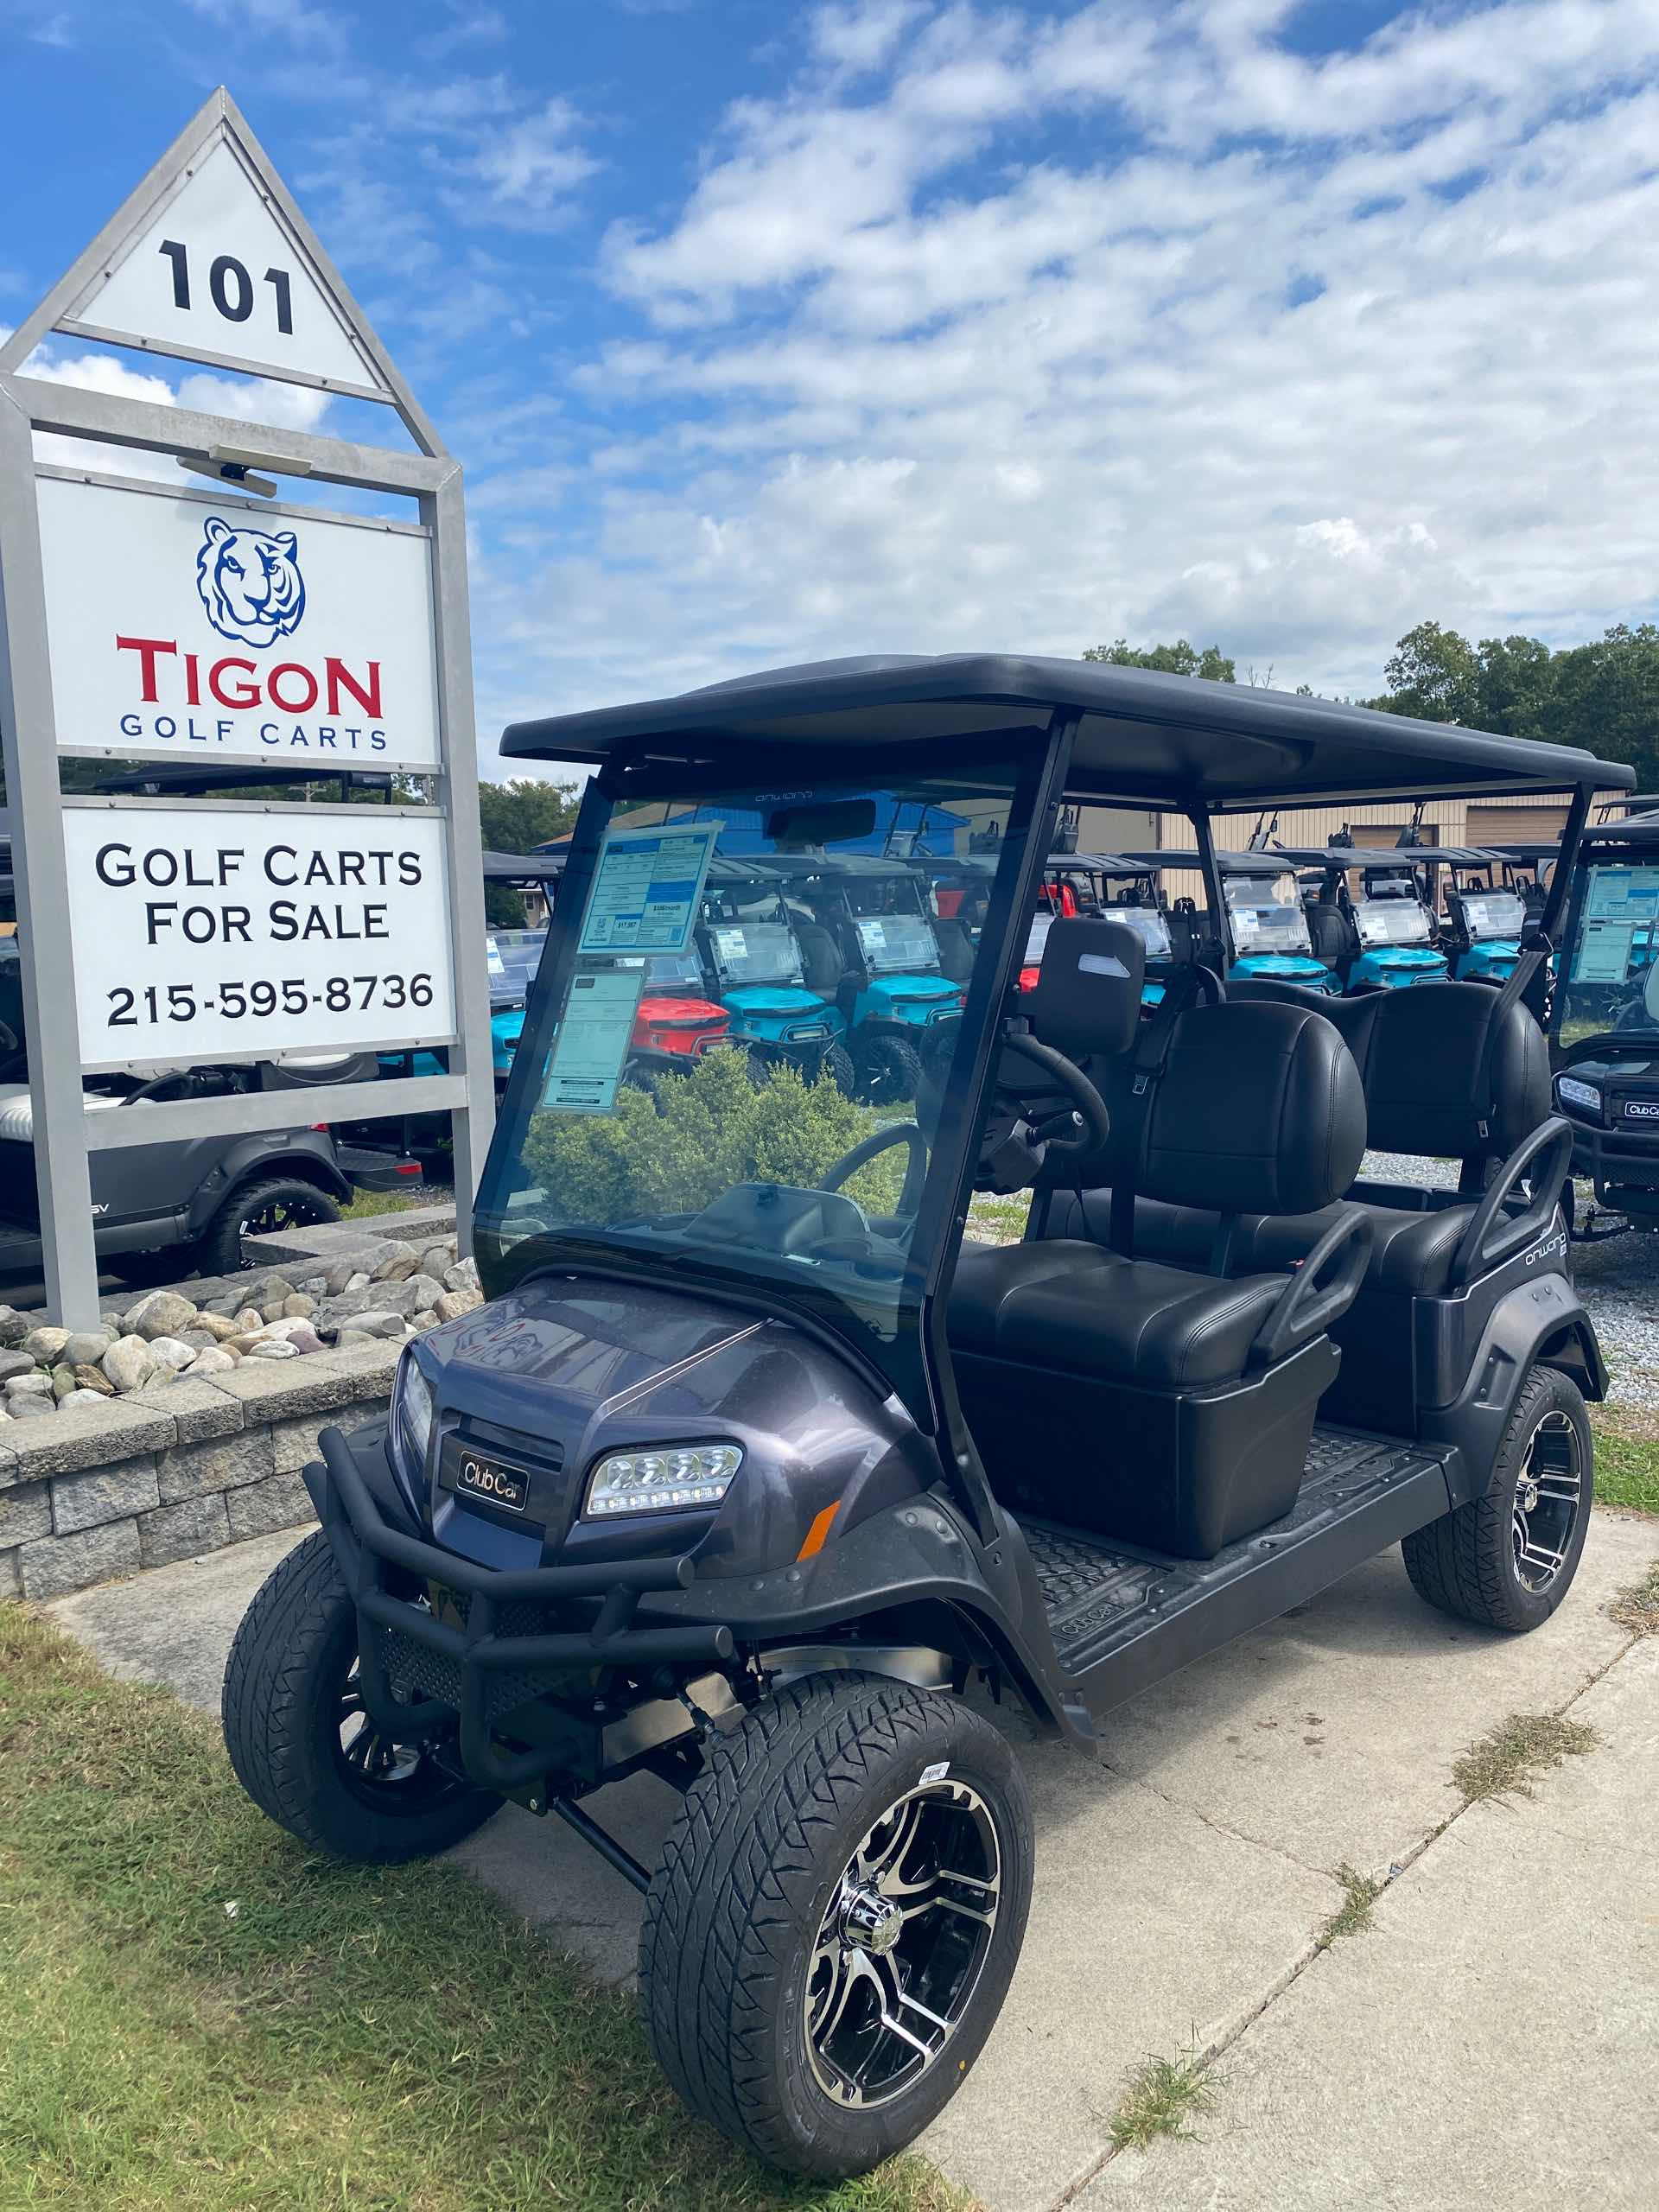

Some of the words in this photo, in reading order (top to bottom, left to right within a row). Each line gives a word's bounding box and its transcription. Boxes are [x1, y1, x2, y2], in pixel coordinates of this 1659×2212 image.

[158, 239, 294, 335] 101
[116, 633, 384, 719] TIGON
[120, 714, 234, 741] GOLF
[260, 722, 386, 750] CARTS
[95, 842, 245, 887] GOLF
[264, 844, 423, 886] CARTS
[144, 900, 253, 944] FOR
[269, 899, 390, 941] SALE
[106, 973, 433, 1027] 215-595-8736
[465, 1461, 494, 1491] Club
